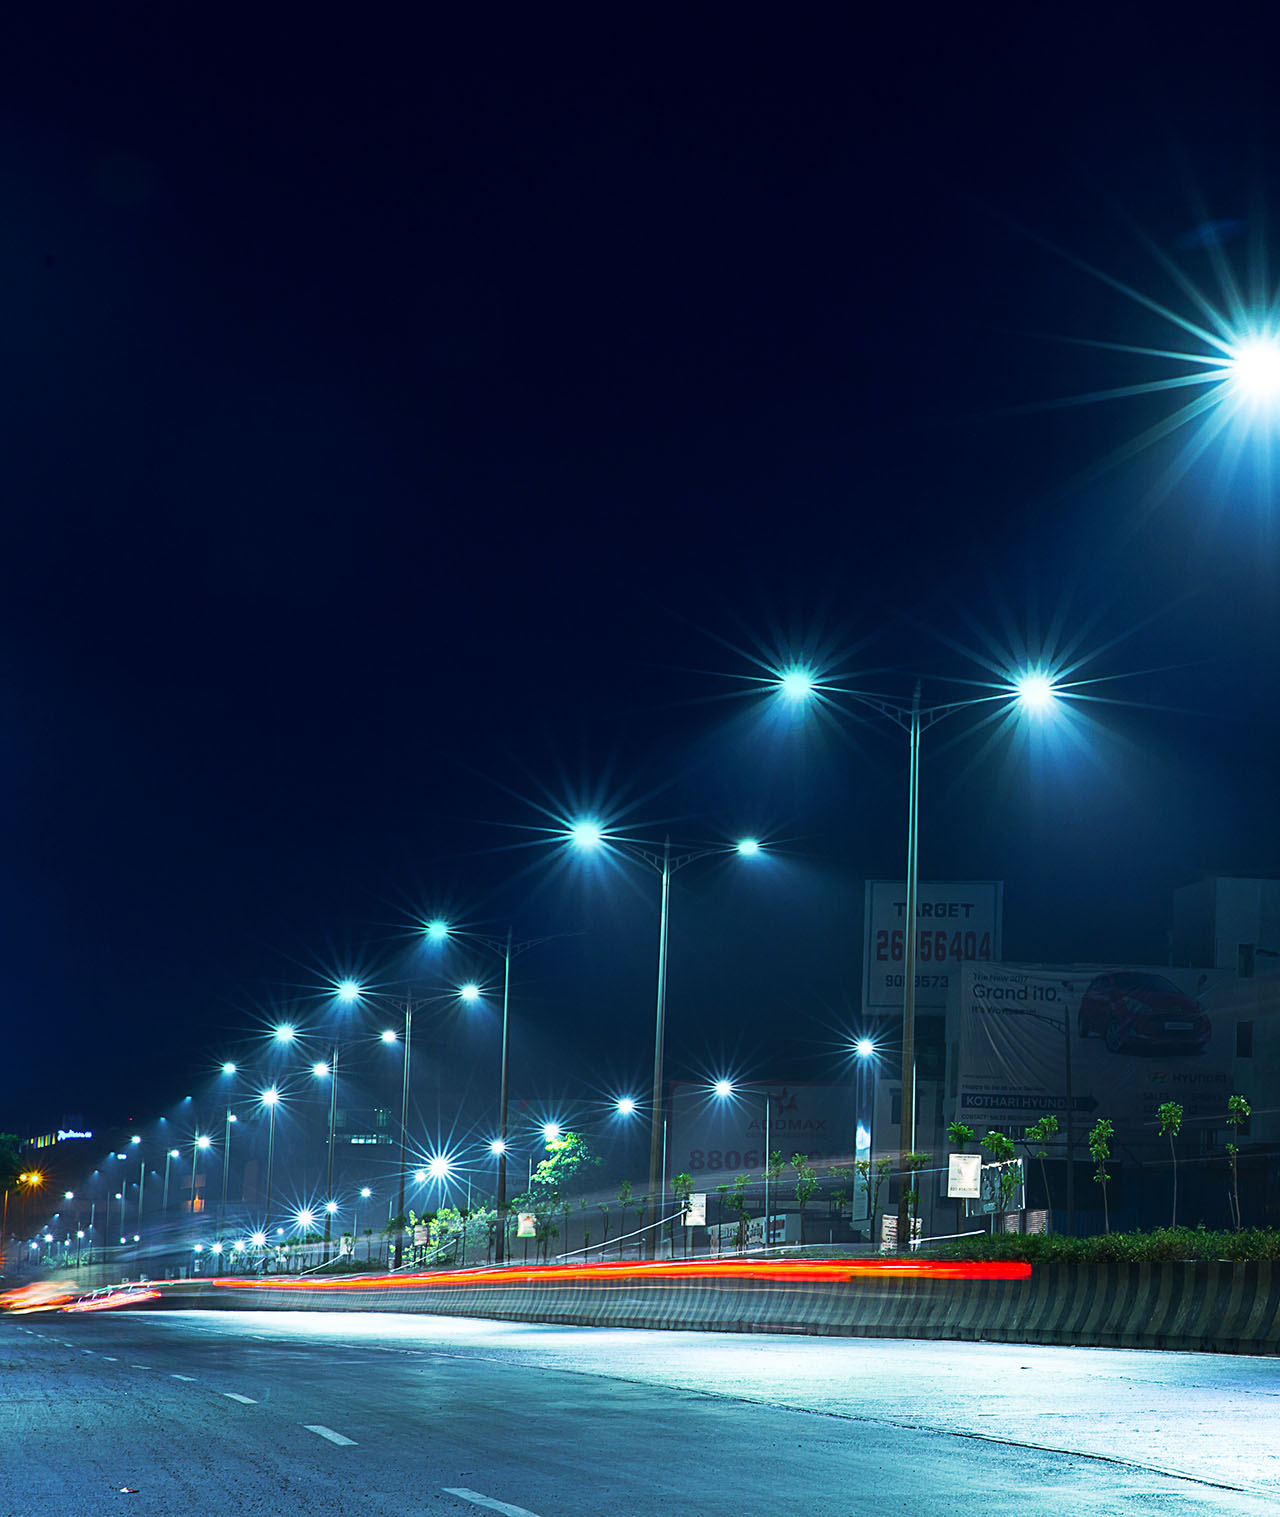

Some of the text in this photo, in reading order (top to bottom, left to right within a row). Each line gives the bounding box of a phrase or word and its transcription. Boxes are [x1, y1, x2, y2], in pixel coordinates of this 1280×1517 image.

[893, 902, 974, 918] TRGET
[876, 929, 991, 962] 2656404
[973, 984, 1027, 1000] Grand
[966, 1096, 1019, 1107] KOTHARI
